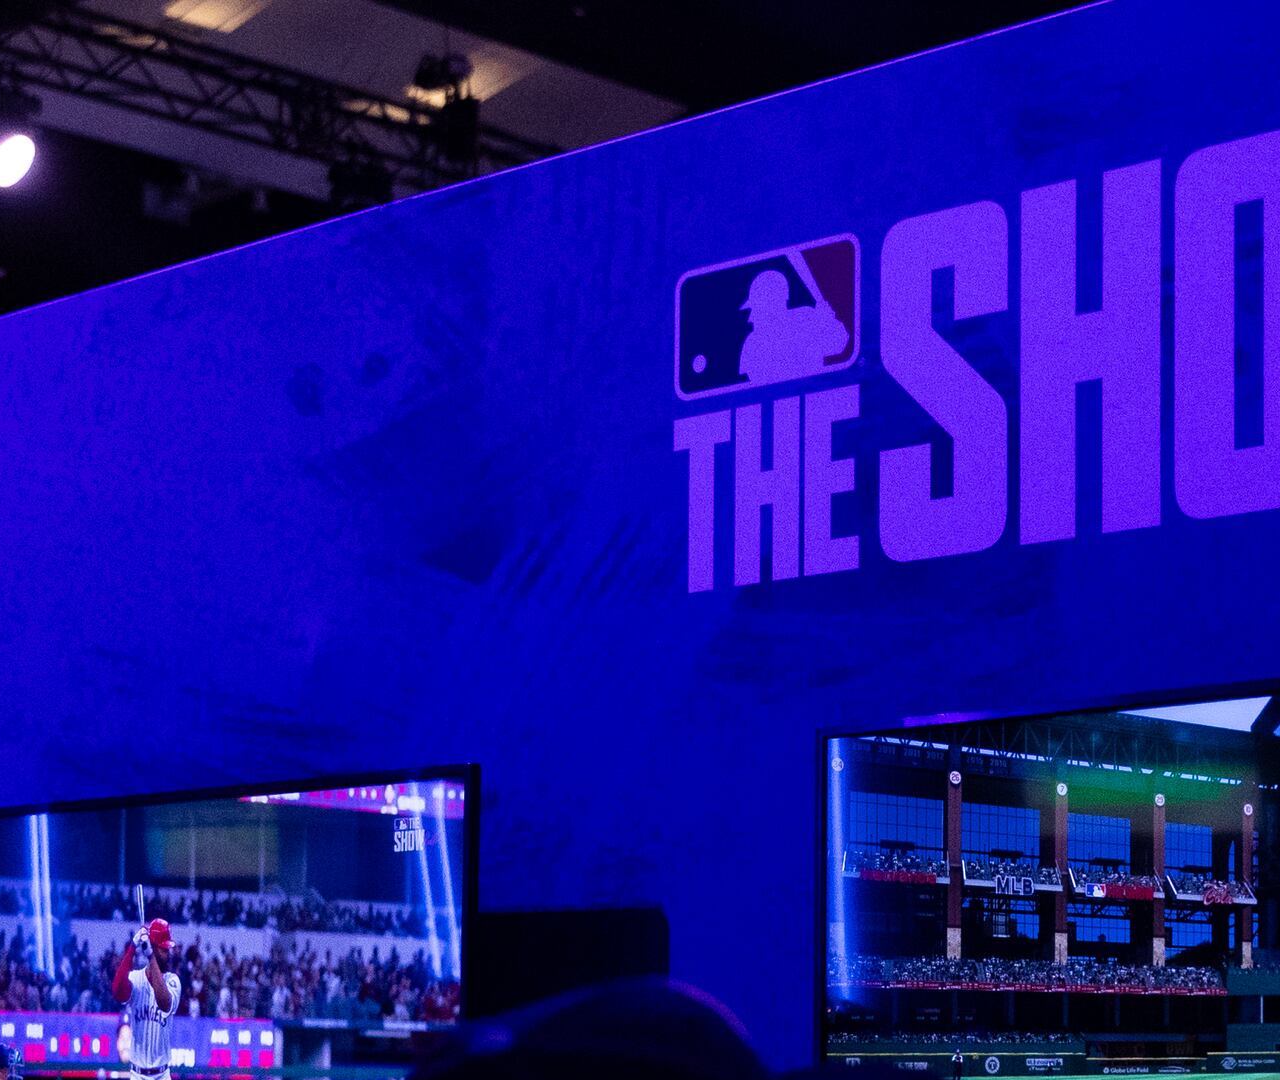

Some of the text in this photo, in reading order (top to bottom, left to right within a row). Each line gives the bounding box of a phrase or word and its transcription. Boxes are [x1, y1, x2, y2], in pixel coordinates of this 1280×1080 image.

[673, 384, 862, 594] THE
[394, 829, 425, 852] SHOW
[995, 874, 1035, 896] MLB
